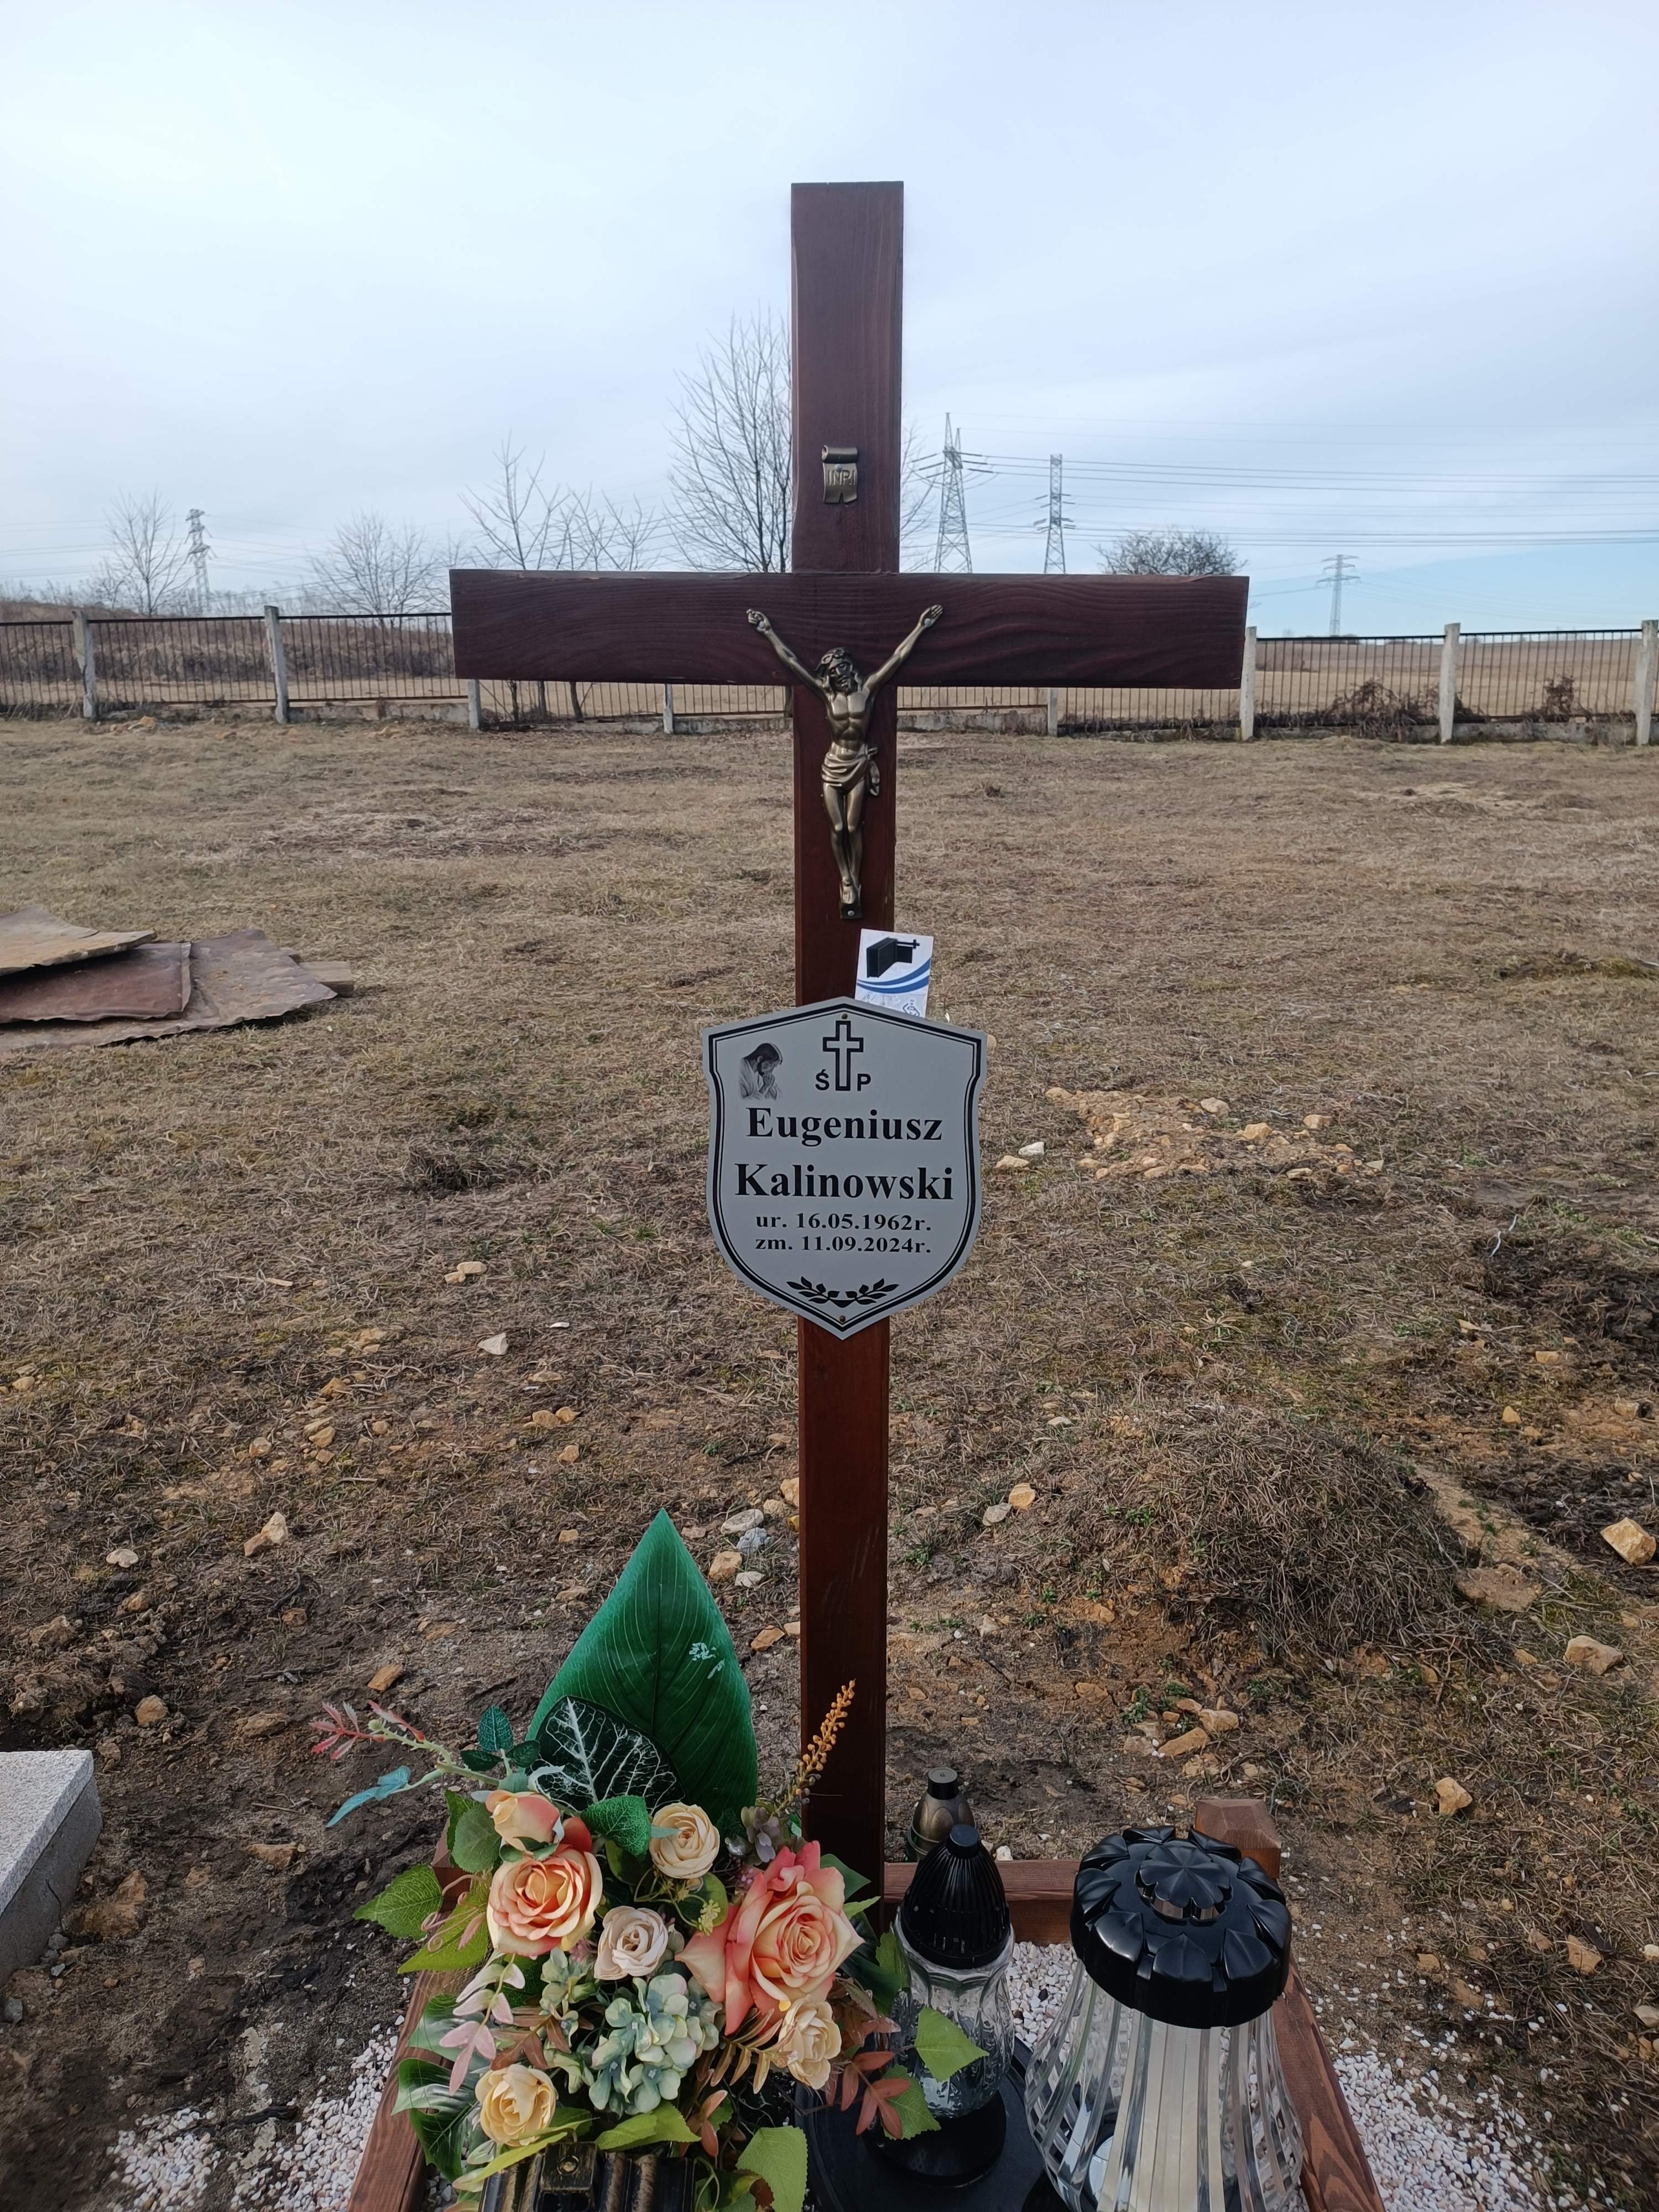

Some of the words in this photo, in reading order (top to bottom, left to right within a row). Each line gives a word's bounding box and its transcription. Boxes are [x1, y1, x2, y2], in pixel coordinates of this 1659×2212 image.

[815, 1069, 830, 1091] Ś
[857, 1073, 872, 1092] P
[746, 1107, 943, 1147] Eugeniusz
[734, 1163, 953, 1200] Kalinowski
[756, 1216, 787, 1228] ur.
[796, 1213, 931, 1231] 16.05.1962r.
[755, 1239, 793, 1250] zm.
[801, 1235, 931, 1253] 11.09.2024r.
